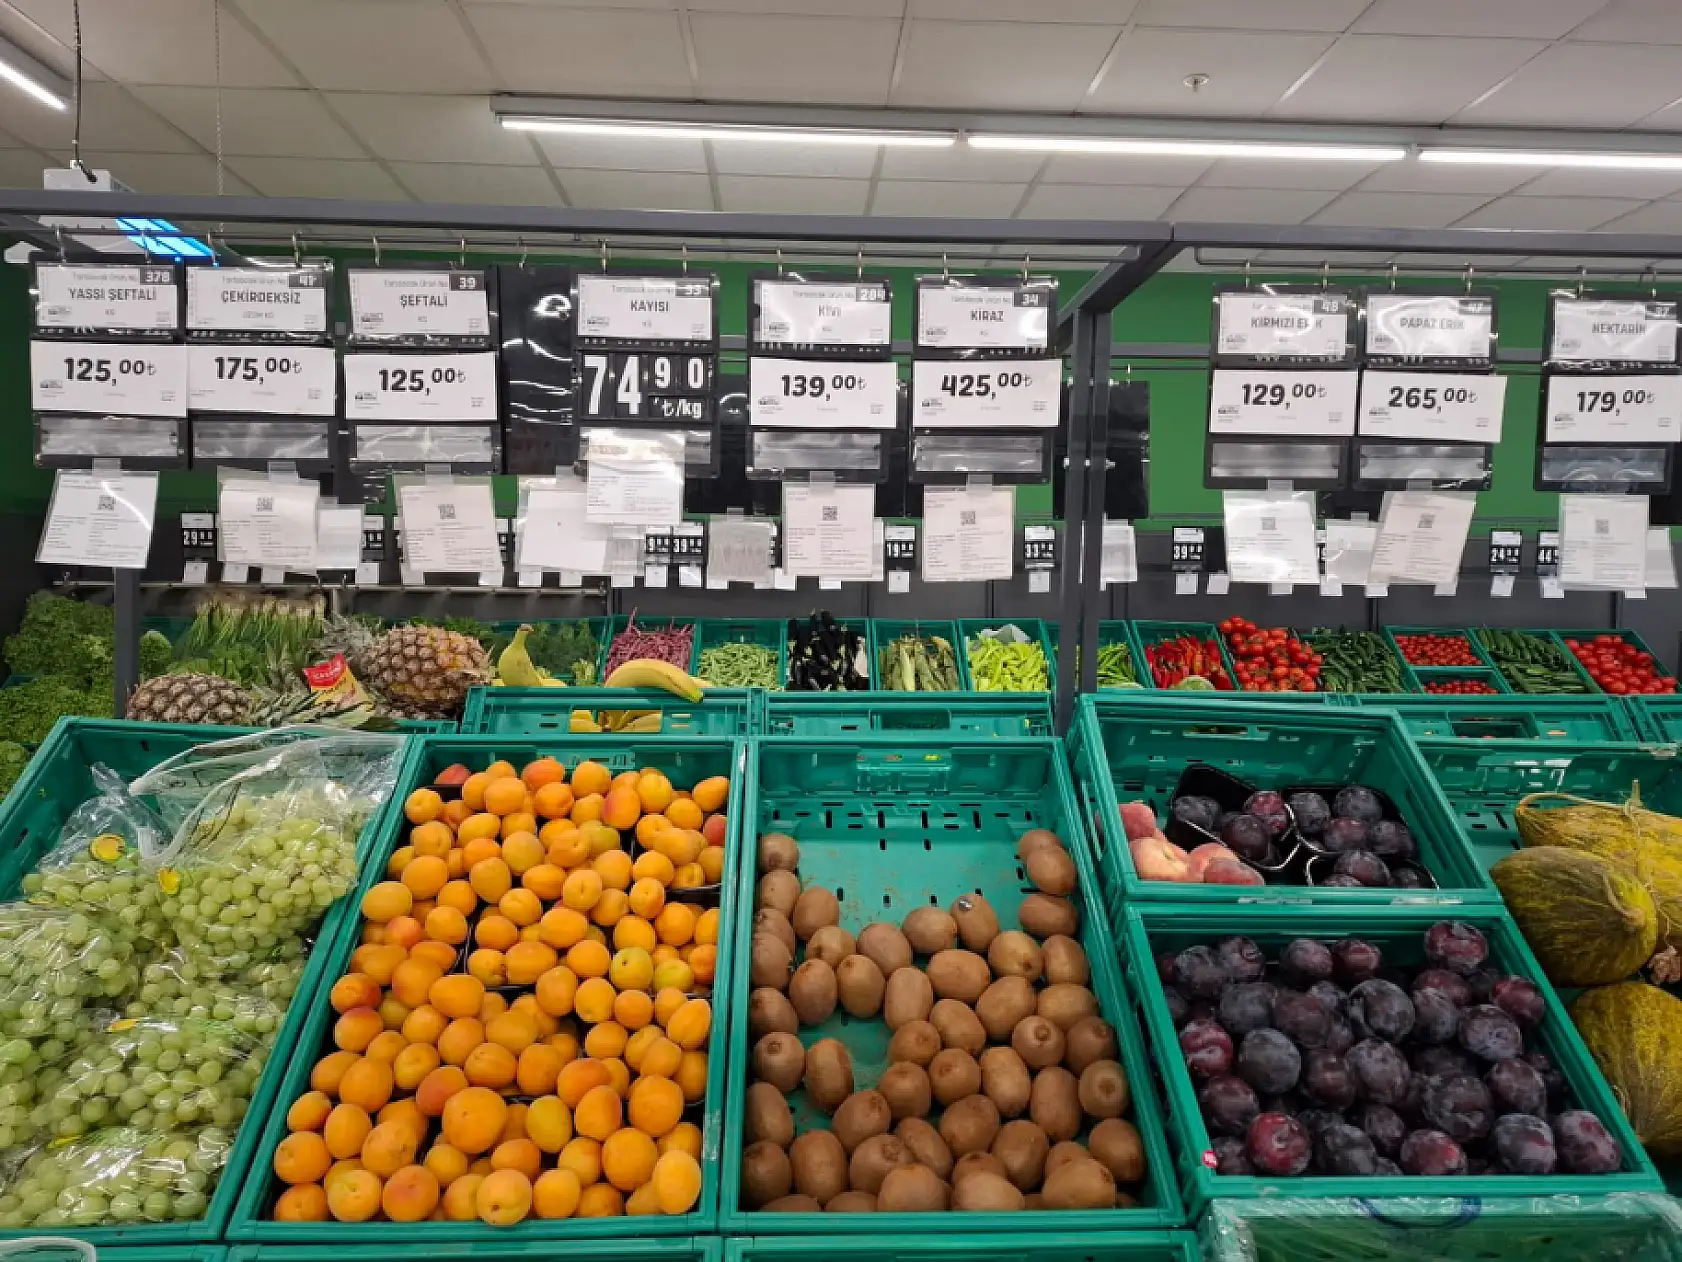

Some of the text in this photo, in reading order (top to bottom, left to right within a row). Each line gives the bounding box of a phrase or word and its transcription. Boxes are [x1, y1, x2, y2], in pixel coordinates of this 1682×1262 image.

[458, 277, 476, 289] 39
[69, 286, 157, 302] YASSI ŞEFTALİ
[221, 289, 301, 304] ÇEKİRDEKSİZ
[400, 293, 448, 309] ŞEFTALİ
[1021, 294, 1039, 306] 34
[630, 300, 670, 312] KAYISI
[971, 308, 1004, 322] KİRAZ
[1251, 317, 1323, 329] KIRMIZI ERK
[1400, 317, 1436, 329] PAPAZ
[1591, 322, 1647, 334] NEKTARİN
[64, 357, 157, 387] 125,00₺
[214, 356, 302, 385] 175,00₺
[378, 367, 466, 396] 125,00₺
[781, 374, 867, 401] 139,00₺
[941, 373, 1033, 400] 425,00₺
[1241, 383, 1328, 410] 129,00₺
[1388, 386, 1478, 414] 265,00₺
[1576, 389, 1656, 416] 179,00₺
